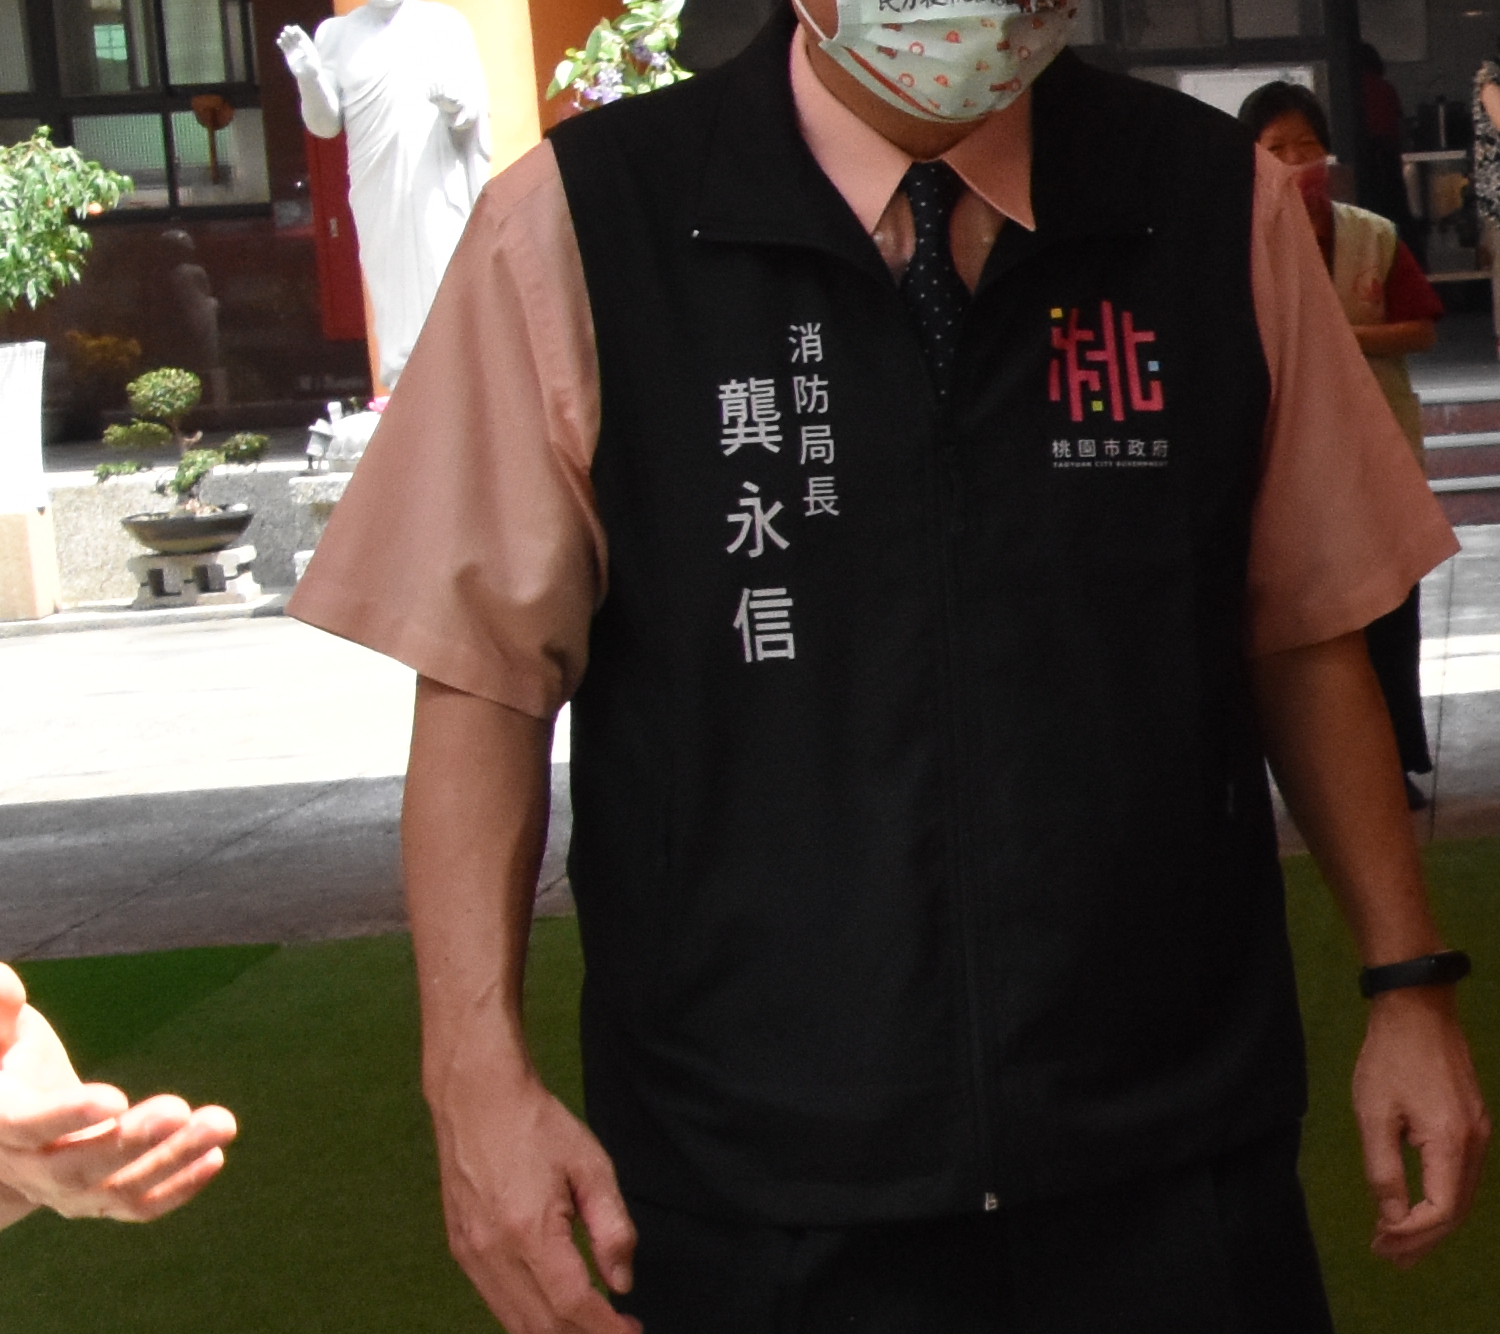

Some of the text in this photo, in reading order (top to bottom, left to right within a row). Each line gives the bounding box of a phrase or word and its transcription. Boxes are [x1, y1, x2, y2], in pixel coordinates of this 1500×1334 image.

[788, 322, 841, 518] 消防局長
[1051, 438, 1169, 459] 桃園市政府
[718, 376, 797, 663] 龔永信
